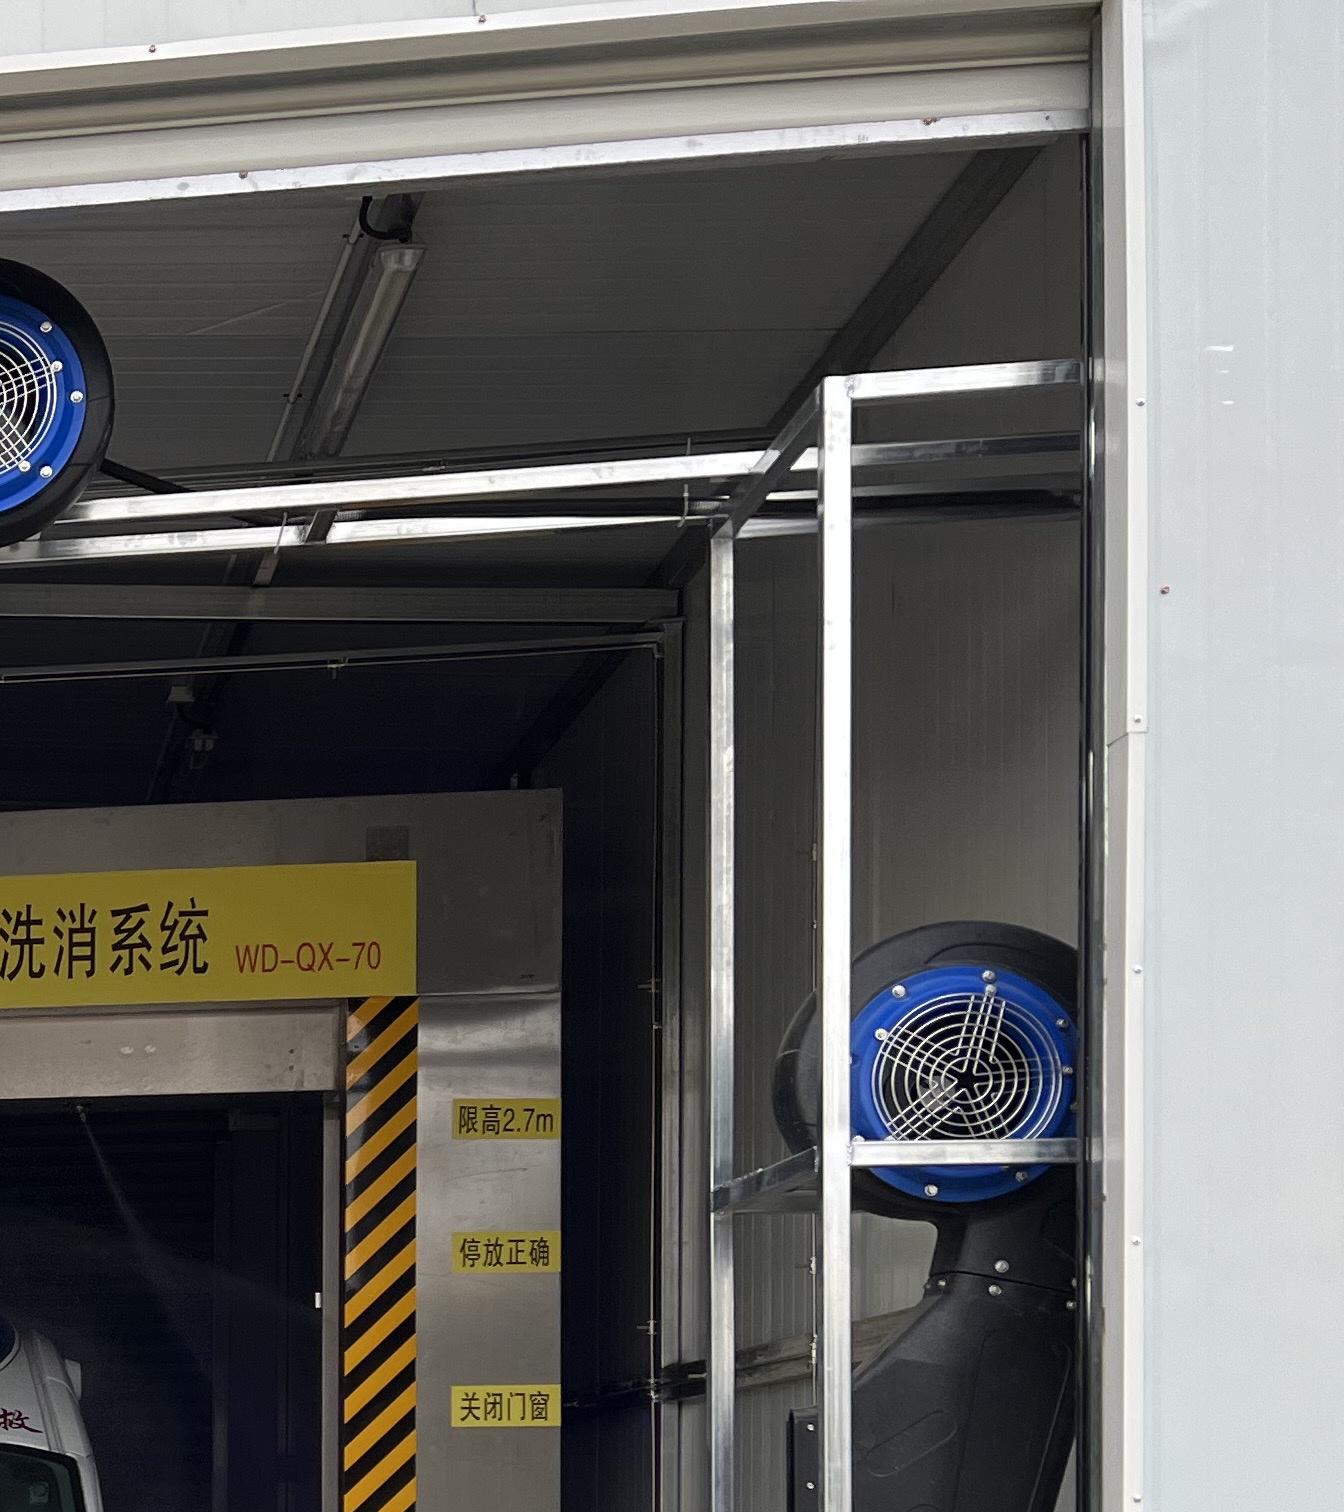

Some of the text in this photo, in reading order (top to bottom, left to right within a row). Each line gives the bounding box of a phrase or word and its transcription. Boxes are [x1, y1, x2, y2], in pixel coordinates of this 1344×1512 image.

[235, 941, 381, 974] WD-QX-70
[458, 1104, 554, 1135] 限高2.7m
[459, 1237, 551, 1267] 停放正确
[460, 1391, 551, 1422] 关闭门窗
